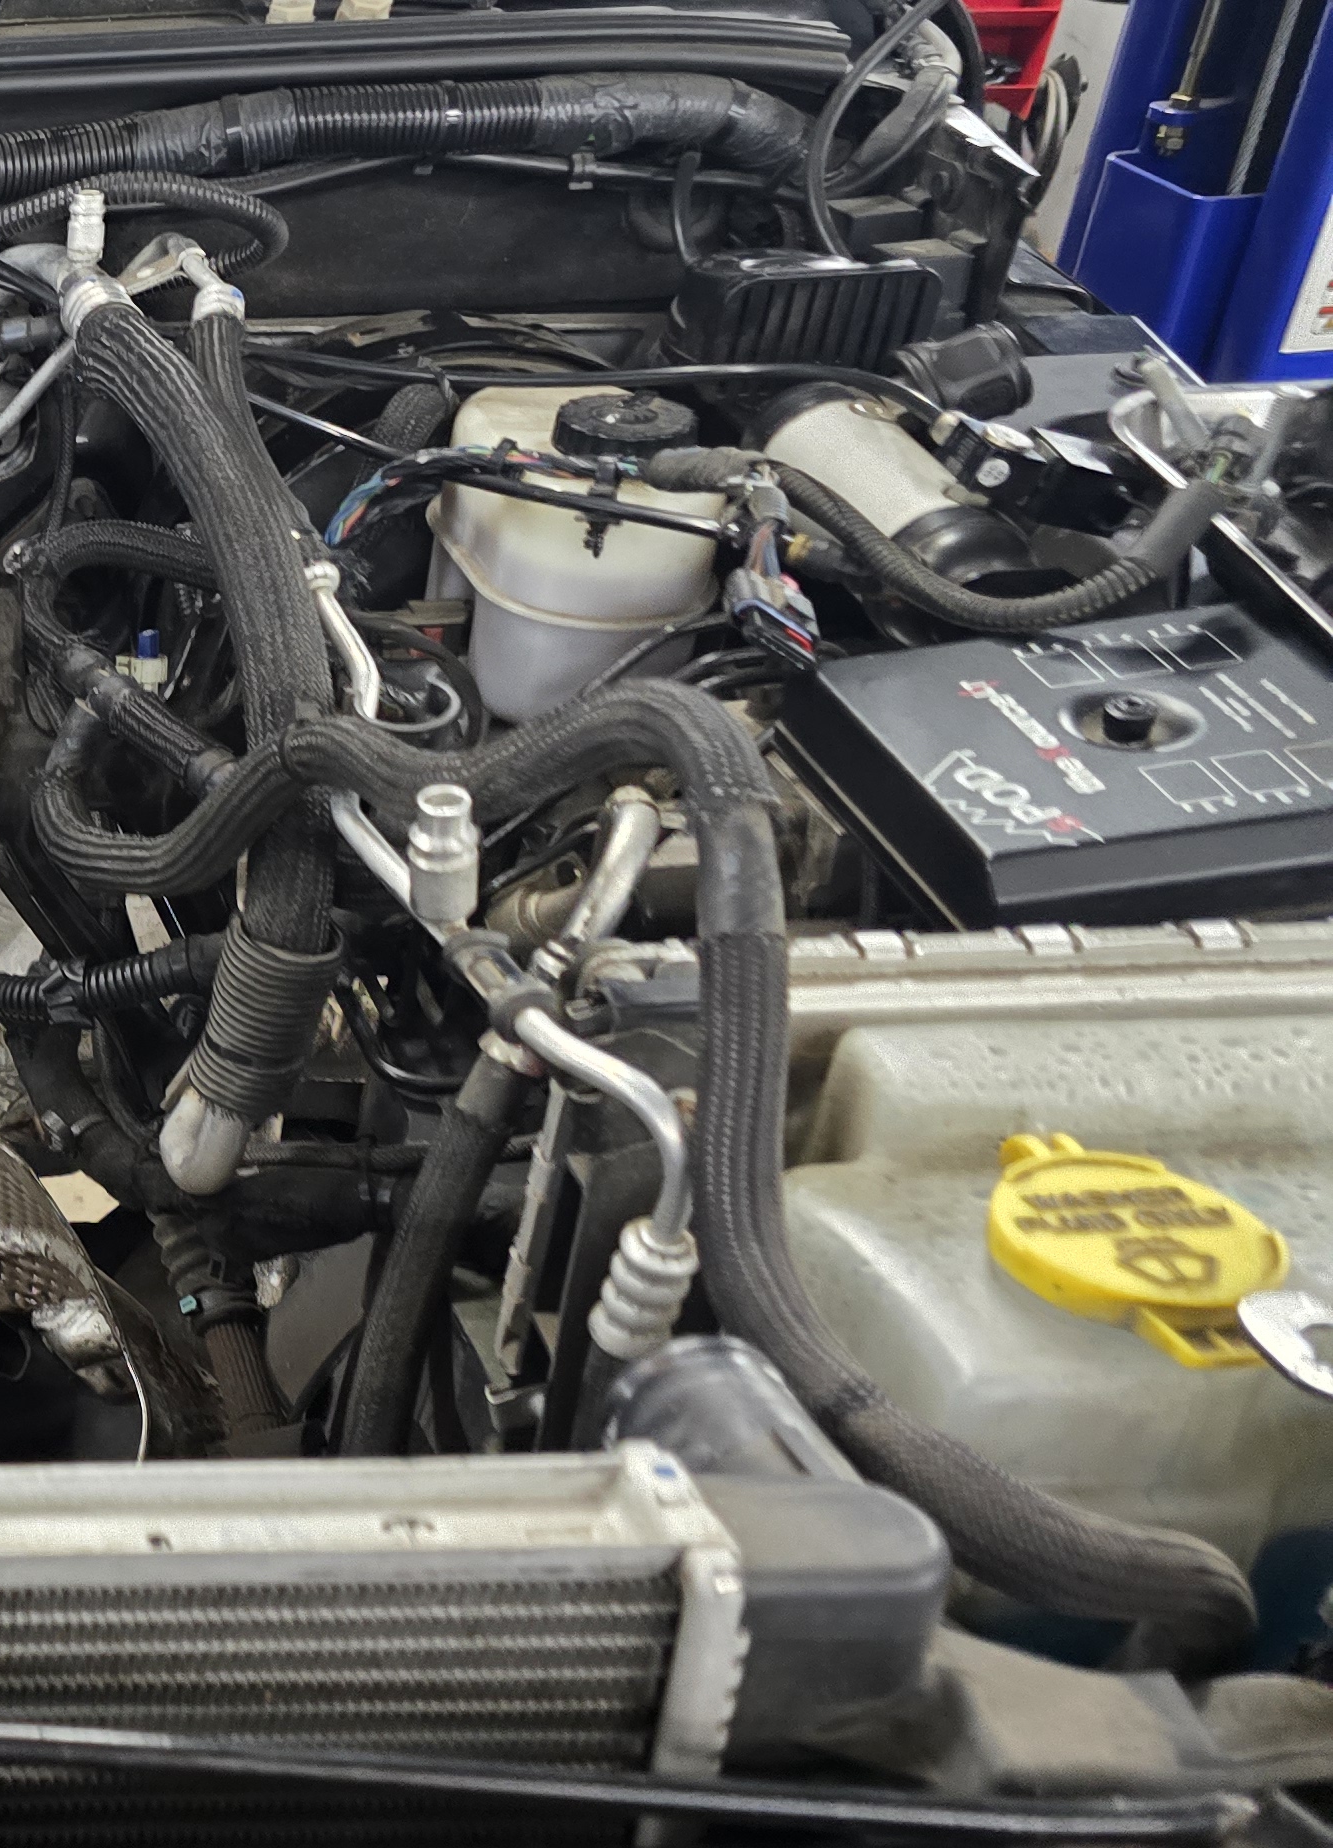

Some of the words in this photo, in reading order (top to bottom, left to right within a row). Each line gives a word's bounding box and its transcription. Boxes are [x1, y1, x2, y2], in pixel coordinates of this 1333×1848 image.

[1021, 1186, 1195, 1210] WASHER
[1014, 1211, 1129, 1235] FLUID
[1134, 1205, 1234, 1229] ONLY
